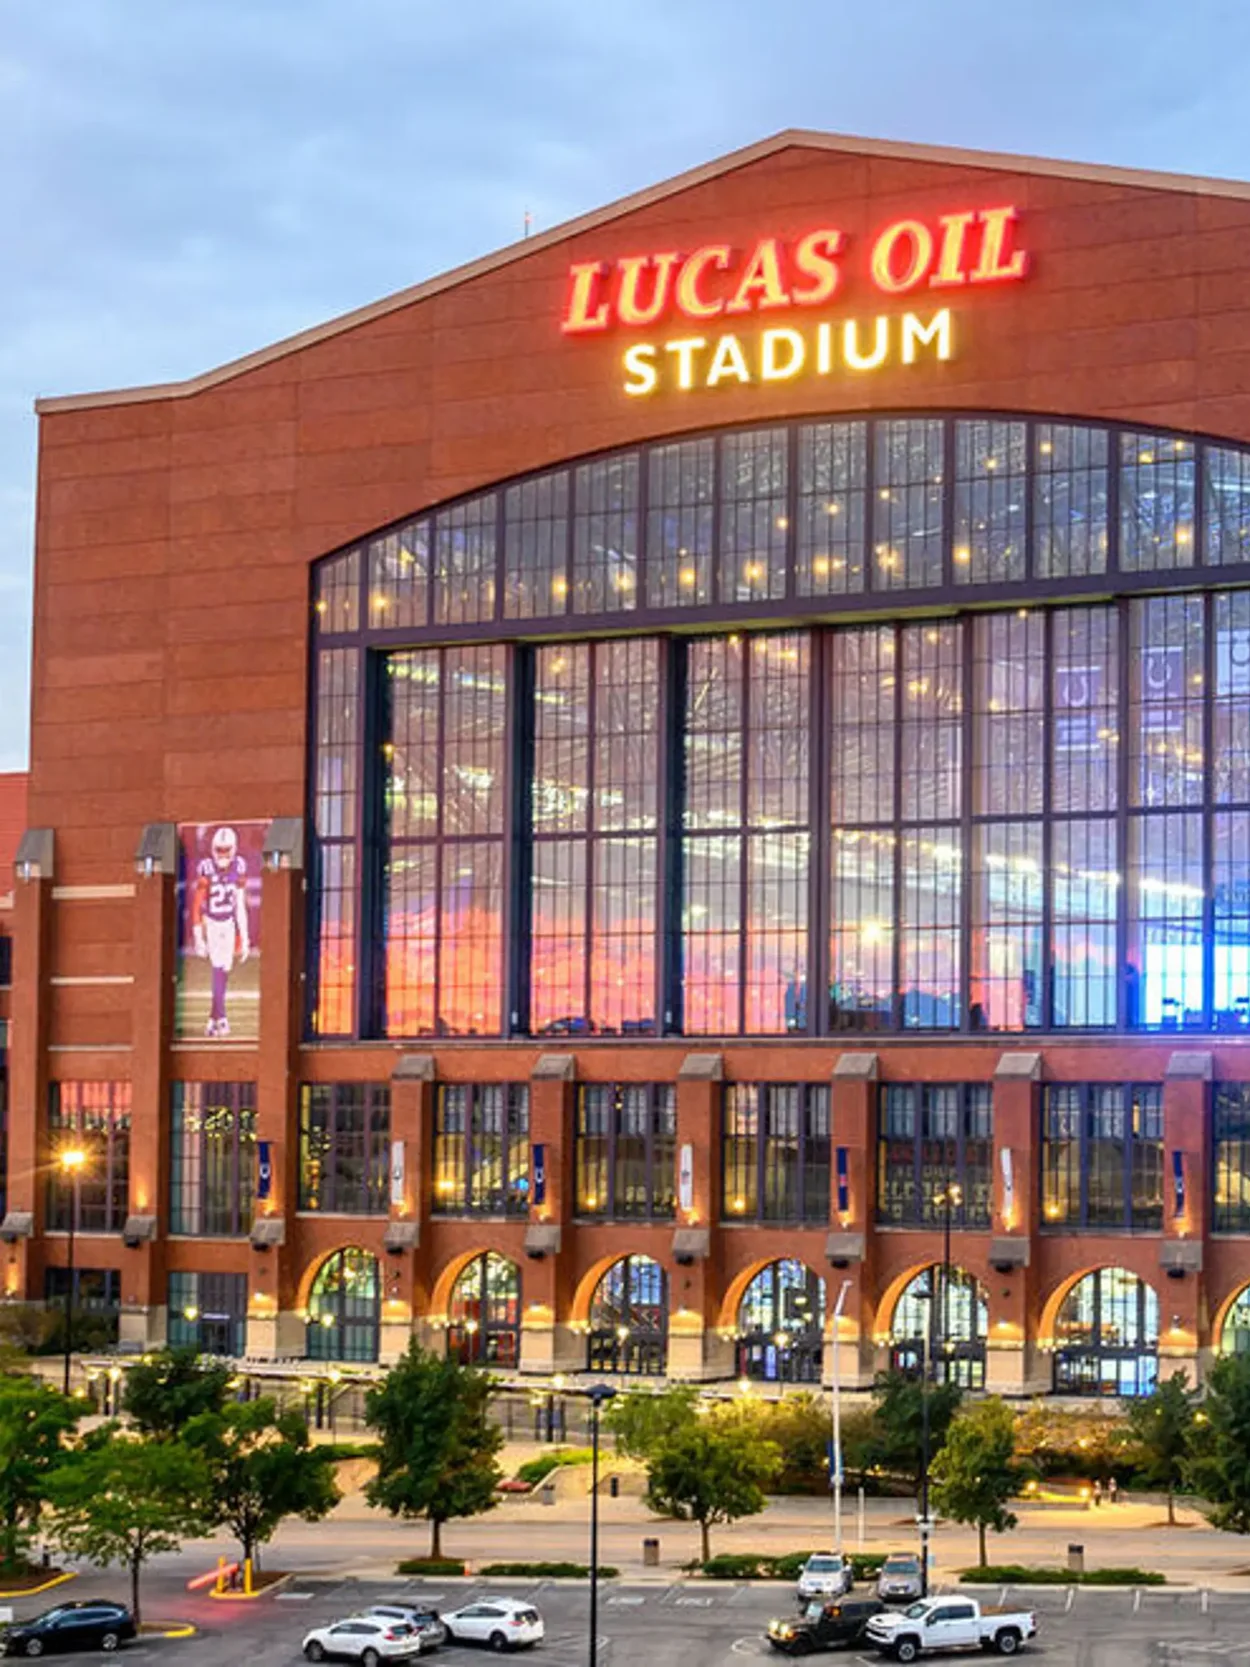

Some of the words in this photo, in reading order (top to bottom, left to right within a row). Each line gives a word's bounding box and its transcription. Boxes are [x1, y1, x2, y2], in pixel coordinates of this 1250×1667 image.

[561, 229, 843, 334] LUCAS
[870, 205, 1028, 293] OIL
[622, 308, 951, 395] STADIUM
[209, 884, 236, 912] 23
